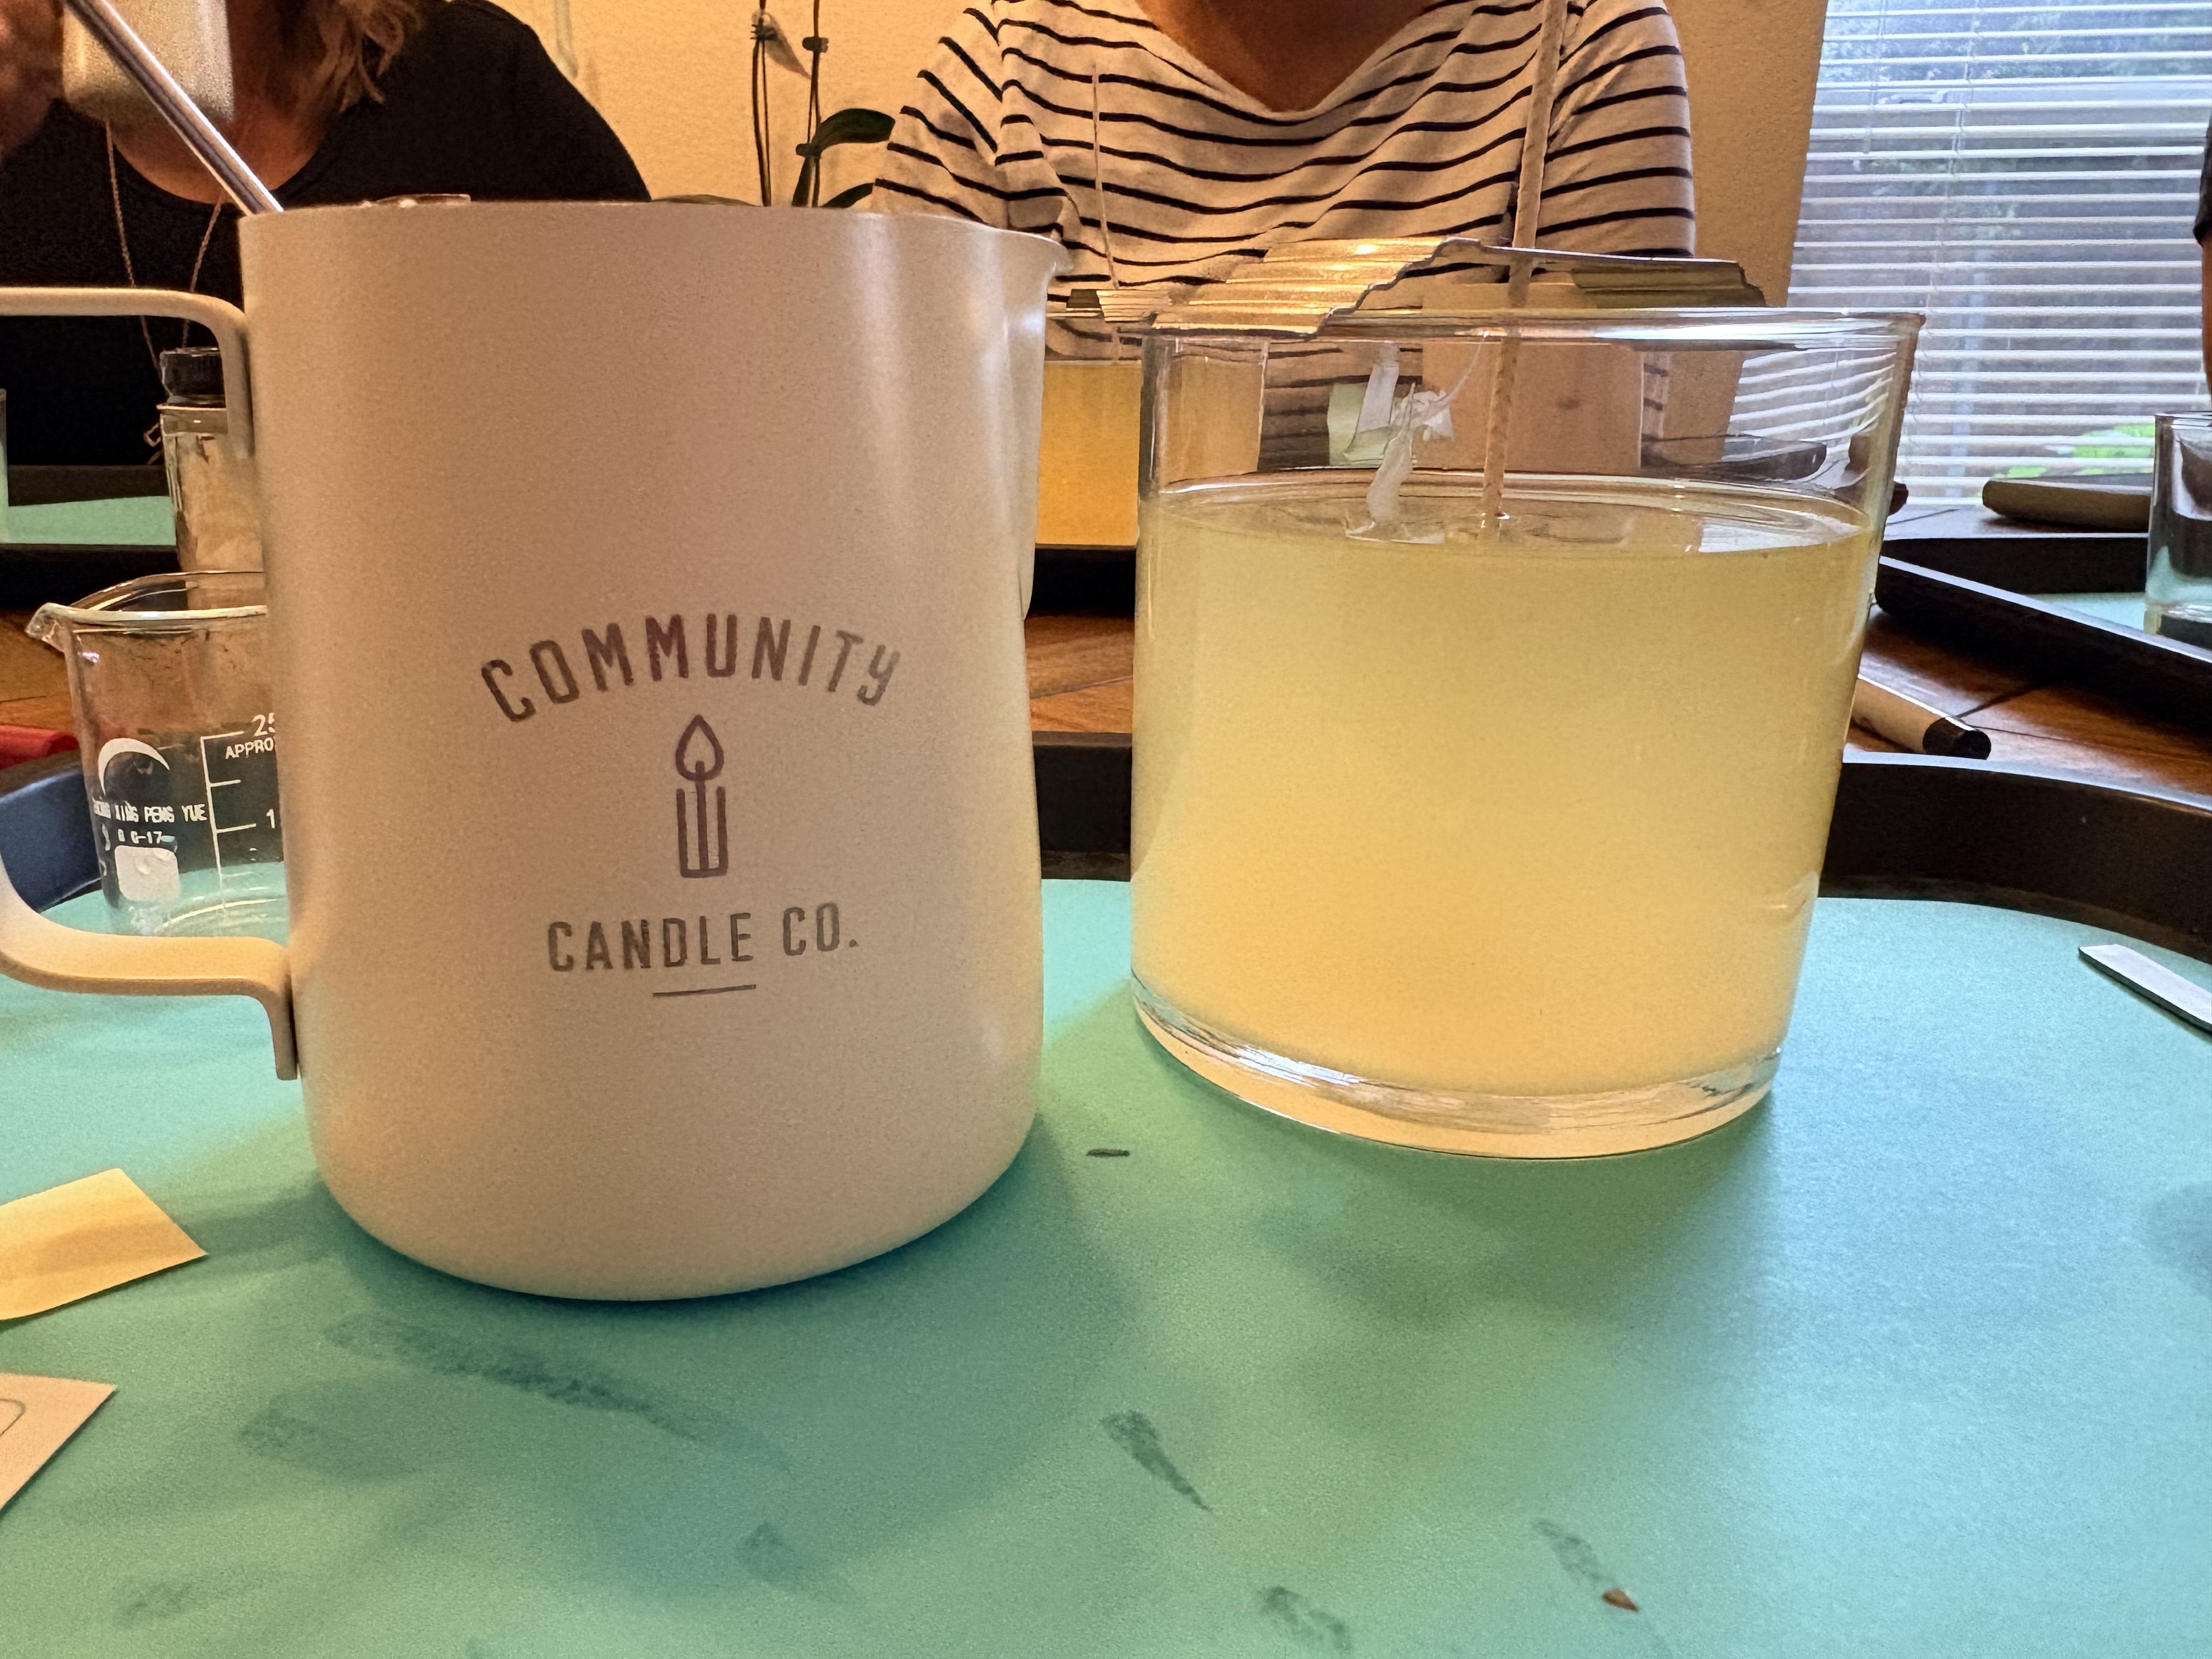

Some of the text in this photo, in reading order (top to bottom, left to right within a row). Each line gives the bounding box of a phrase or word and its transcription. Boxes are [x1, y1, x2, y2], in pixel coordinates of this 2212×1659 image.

[481, 614, 900, 722] COMMUNITY
[225, 737, 275, 759] APPRO
[181, 804, 207, 822] YUE
[549, 902, 859, 971] CANDLE CO.
